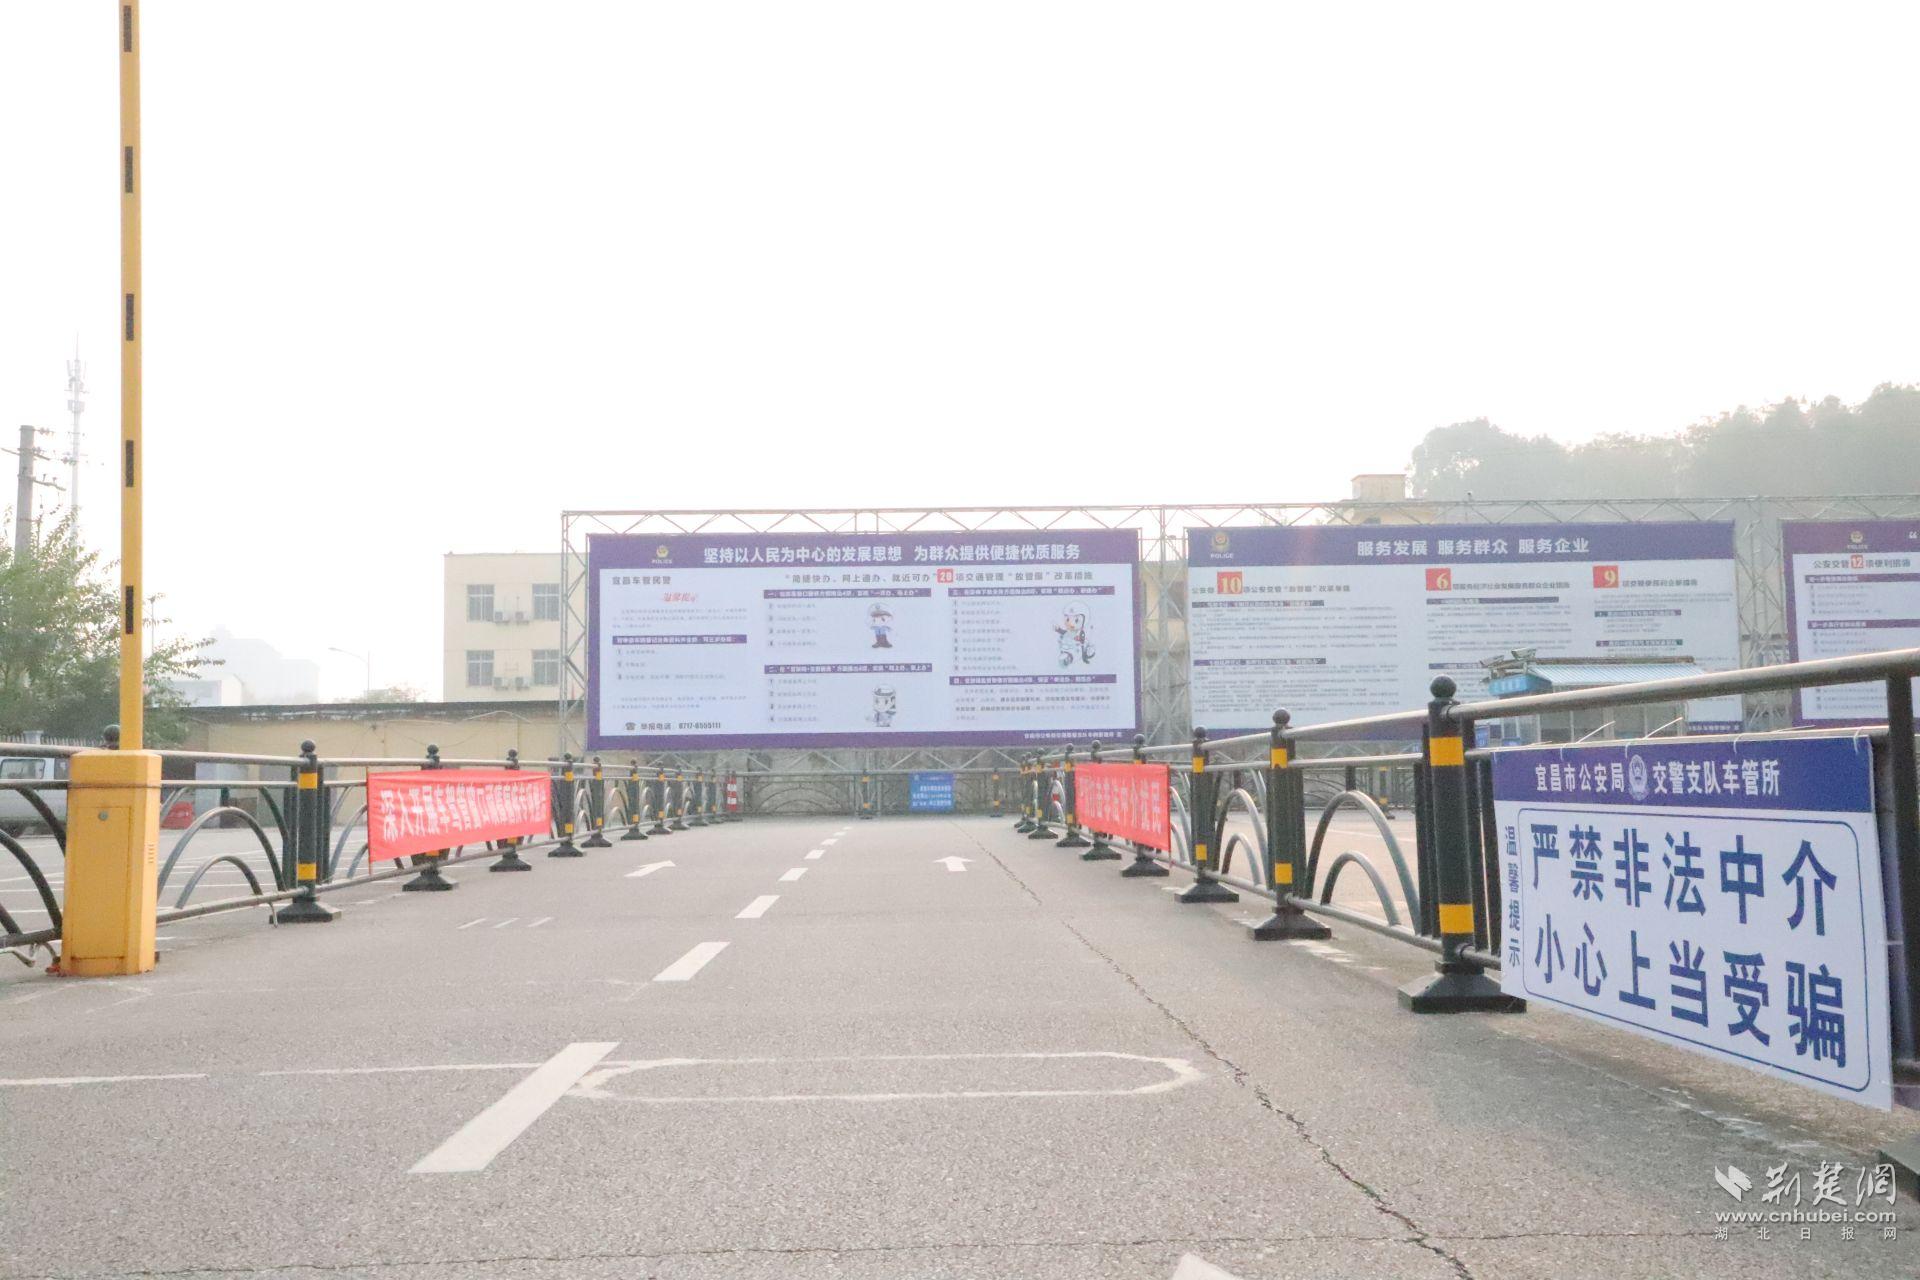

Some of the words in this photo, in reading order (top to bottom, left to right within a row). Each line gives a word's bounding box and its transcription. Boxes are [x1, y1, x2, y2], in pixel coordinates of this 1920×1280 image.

[703, 546, 902, 564] 坚持以人民为中心的发展思想
[914, 544, 1081, 562] 为群众提供便捷优质服务
[1357, 540, 1428, 556] 服务发展
[1438, 539, 1508, 555] 服务群众
[1518, 537, 1590, 554] 服务企业
[1220, 577, 1242, 594] 10
[1436, 572, 1449, 589] 6
[1604, 569, 1616, 586] 9
[1535, 762, 1625, 793] 宜昌市公安局
[1652, 759, 1780, 796] 交警支队车管所
[1530, 823, 1838, 937] 严禁非法中介
[1504, 825, 1521, 968] 温馨提示
[1534, 913, 1847, 1069] 小心上当受骗
